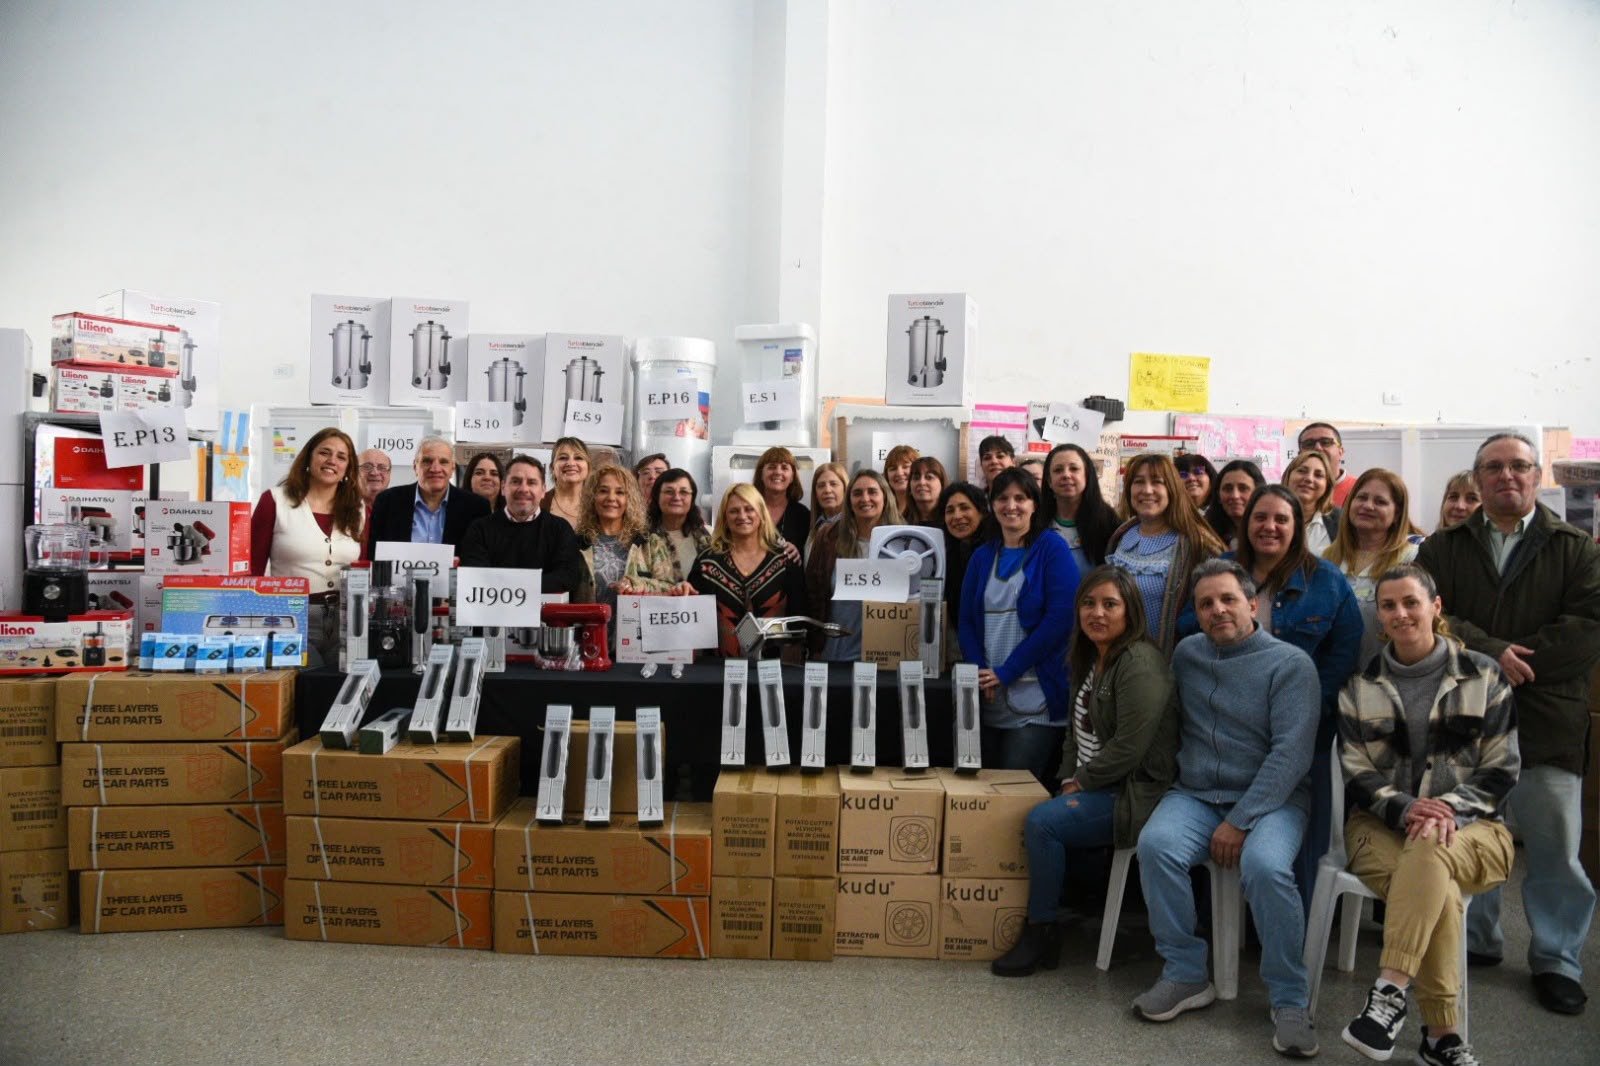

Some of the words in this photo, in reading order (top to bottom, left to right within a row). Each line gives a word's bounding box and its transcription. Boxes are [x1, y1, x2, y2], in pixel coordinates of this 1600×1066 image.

[78, 320, 113, 334] Liliana
[61, 370, 88, 380] Liliana
[121, 376, 147, 385] Liliana
[648, 391, 690, 405] E.P16
[750, 393, 769, 403] E.S
[772, 393, 777, 402] 1
[463, 418, 481, 429] E.S
[486, 419, 500, 429] 10
[573, 411, 591, 422] E.S
[594, 414, 601, 425] 9
[1052, 415, 1069, 429] E.S
[1071, 418, 1080, 432] 8
[113, 427, 176, 448] E.P13
[373, 438, 414, 451] JI905
[1123, 440, 1148, 448] Liliana
[844, 573, 867, 586] E.S
[871, 571, 881, 586] 8
[465, 587, 527, 607] JI909
[649, 611, 699, 625] EE501
[866, 605, 909, 620] kudu
[0, 623, 35, 635] liana
[118, 704, 159, 713] LAYERS
[95, 716, 120, 725] CAR
[123, 715, 163, 725] PARTS
[124, 767, 165, 776] LAYERS
[129, 778, 169, 788] PARTS
[340, 780, 378, 790] LAYERS
[320, 791, 343, 801] CAR
[345, 792, 382, 802] PARTS
[841, 793, 894, 811] kudu
[950, 799, 987, 811] kudu
[95, 830, 128, 840] HREE
[129, 829, 171, 839] LAYERS
[107, 842, 133, 852] CAR
[135, 841, 175, 850] PARTS
[343, 844, 381, 855] LAYERS
[840, 848, 884, 856] EXTRACTOR
[306, 854, 322, 864] OF
[349, 857, 385, 867] PARTS
[555, 855, 595, 865] LAYERS
[534, 867, 559, 877] CAR
[561, 867, 599, 877] PARTS
[838, 877, 890, 895] kudu
[947, 883, 999, 901] kudu
[106, 895, 140, 905] THREE
[142, 894, 183, 904] LAYERS
[101, 907, 117, 917] OF
[120, 906, 146, 916] CAR
[149, 905, 188, 915] PARTS
[340, 906, 378, 916] LAYERS
[303, 916, 317, 925] OF
[345, 918, 381, 928] PARTS
[554, 919, 594, 929] LAYERS
[561, 931, 598, 940] PARTS
[945, 937, 988, 945] EXTRACTOR
